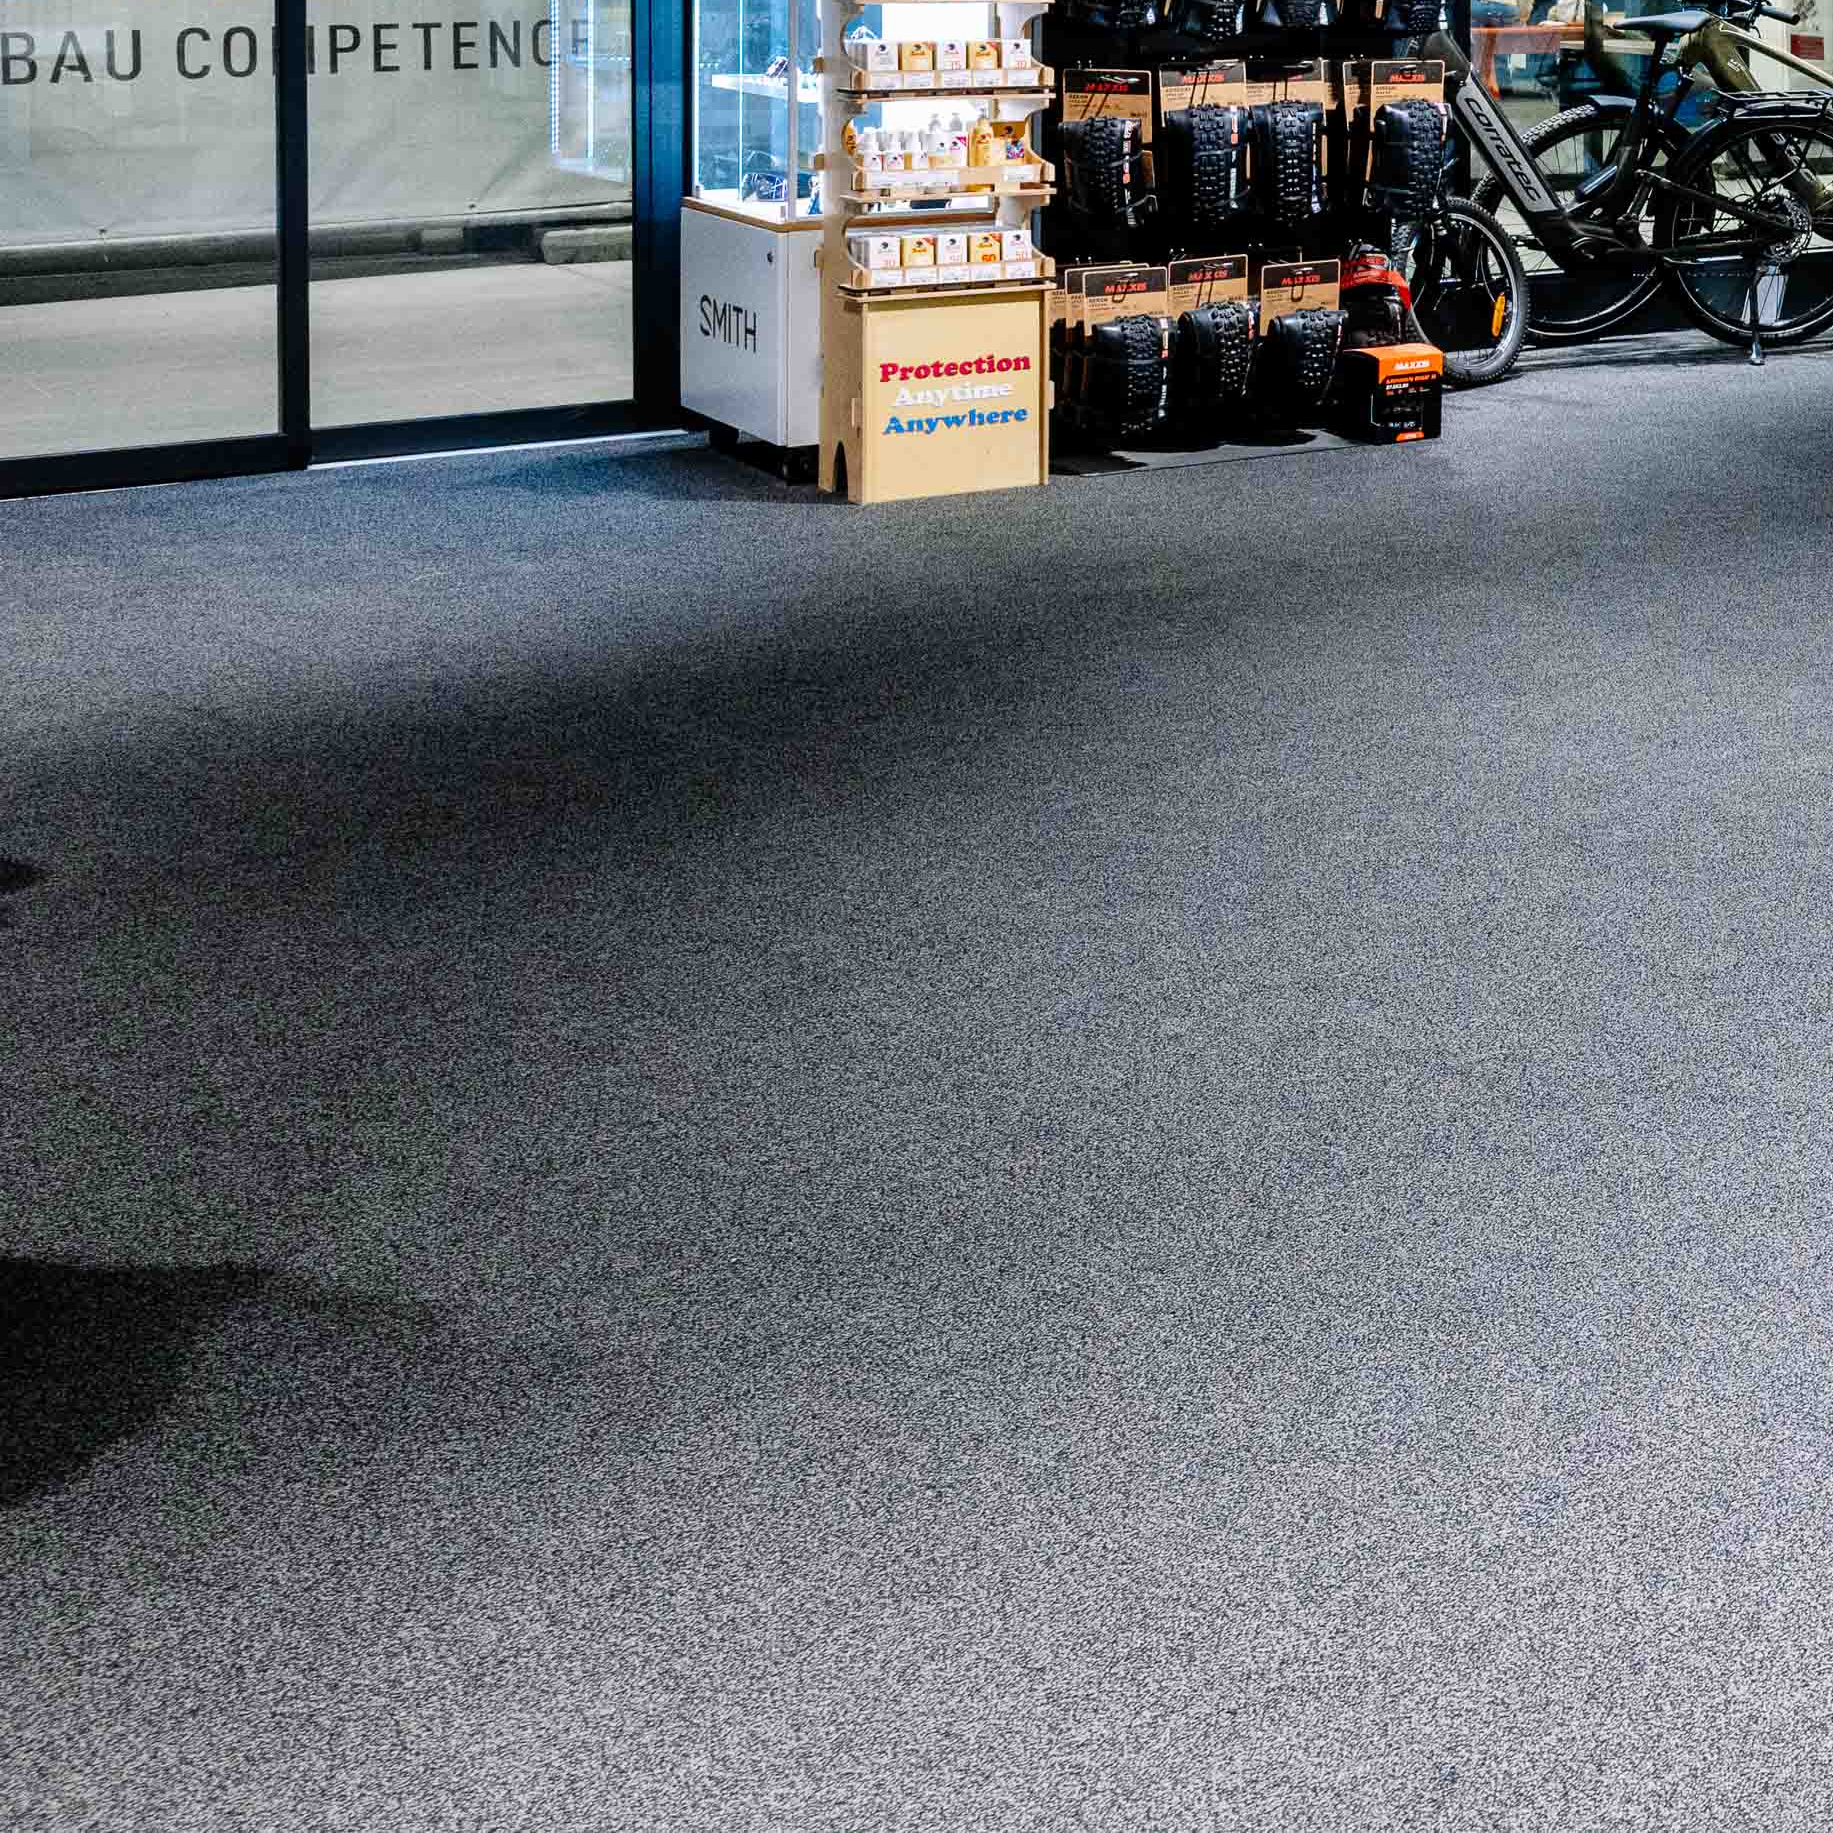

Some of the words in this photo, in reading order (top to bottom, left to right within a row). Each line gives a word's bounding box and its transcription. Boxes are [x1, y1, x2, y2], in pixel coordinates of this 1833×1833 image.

[0, 29, 93, 85] BAU
[699, 295, 757, 353] SMITH
[880, 353, 1031, 382] Protection
[891, 381, 1014, 408] Anytime
[883, 407, 1028, 436] Anywhere
